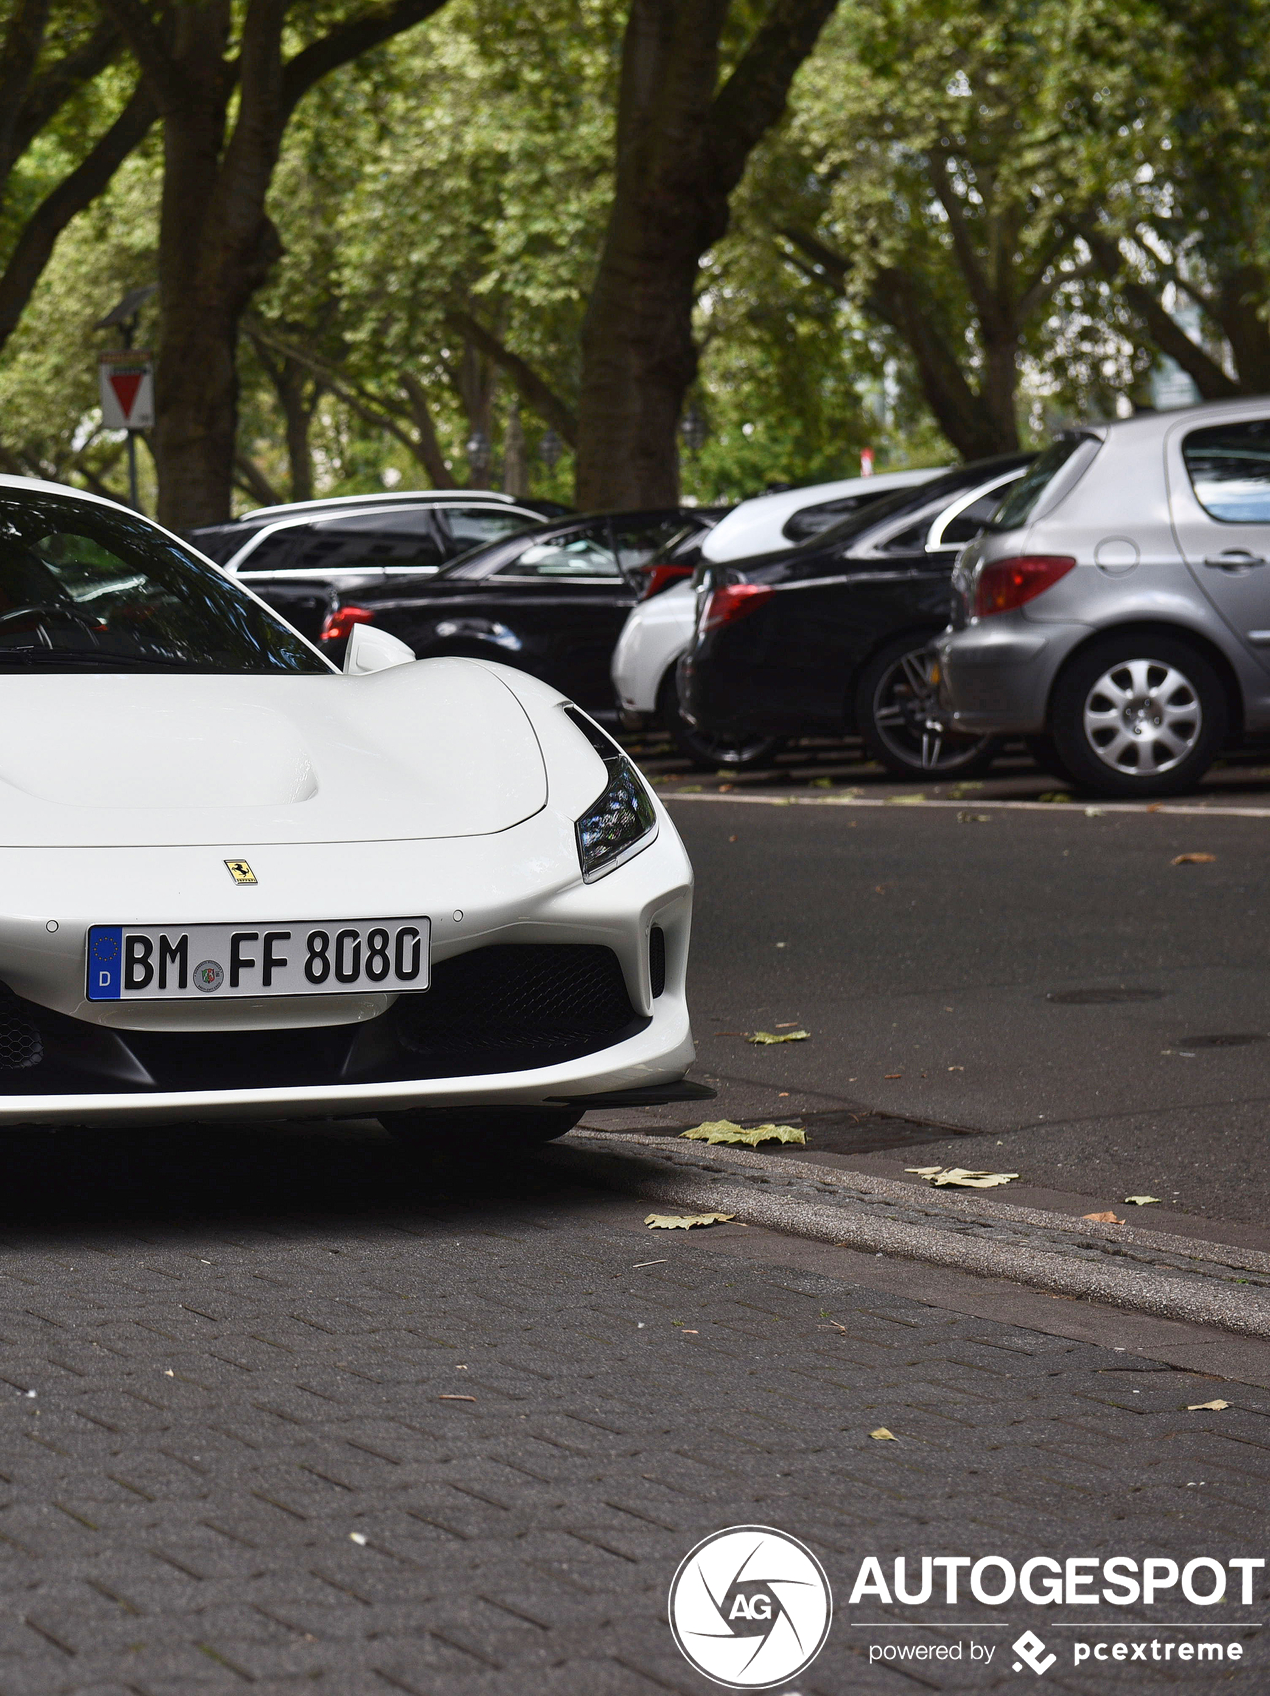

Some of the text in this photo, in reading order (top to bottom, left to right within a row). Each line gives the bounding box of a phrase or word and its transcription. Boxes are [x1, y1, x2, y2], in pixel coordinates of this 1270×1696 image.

[124, 925, 421, 990] BM FF 8080
[99, 971, 111, 987] D
